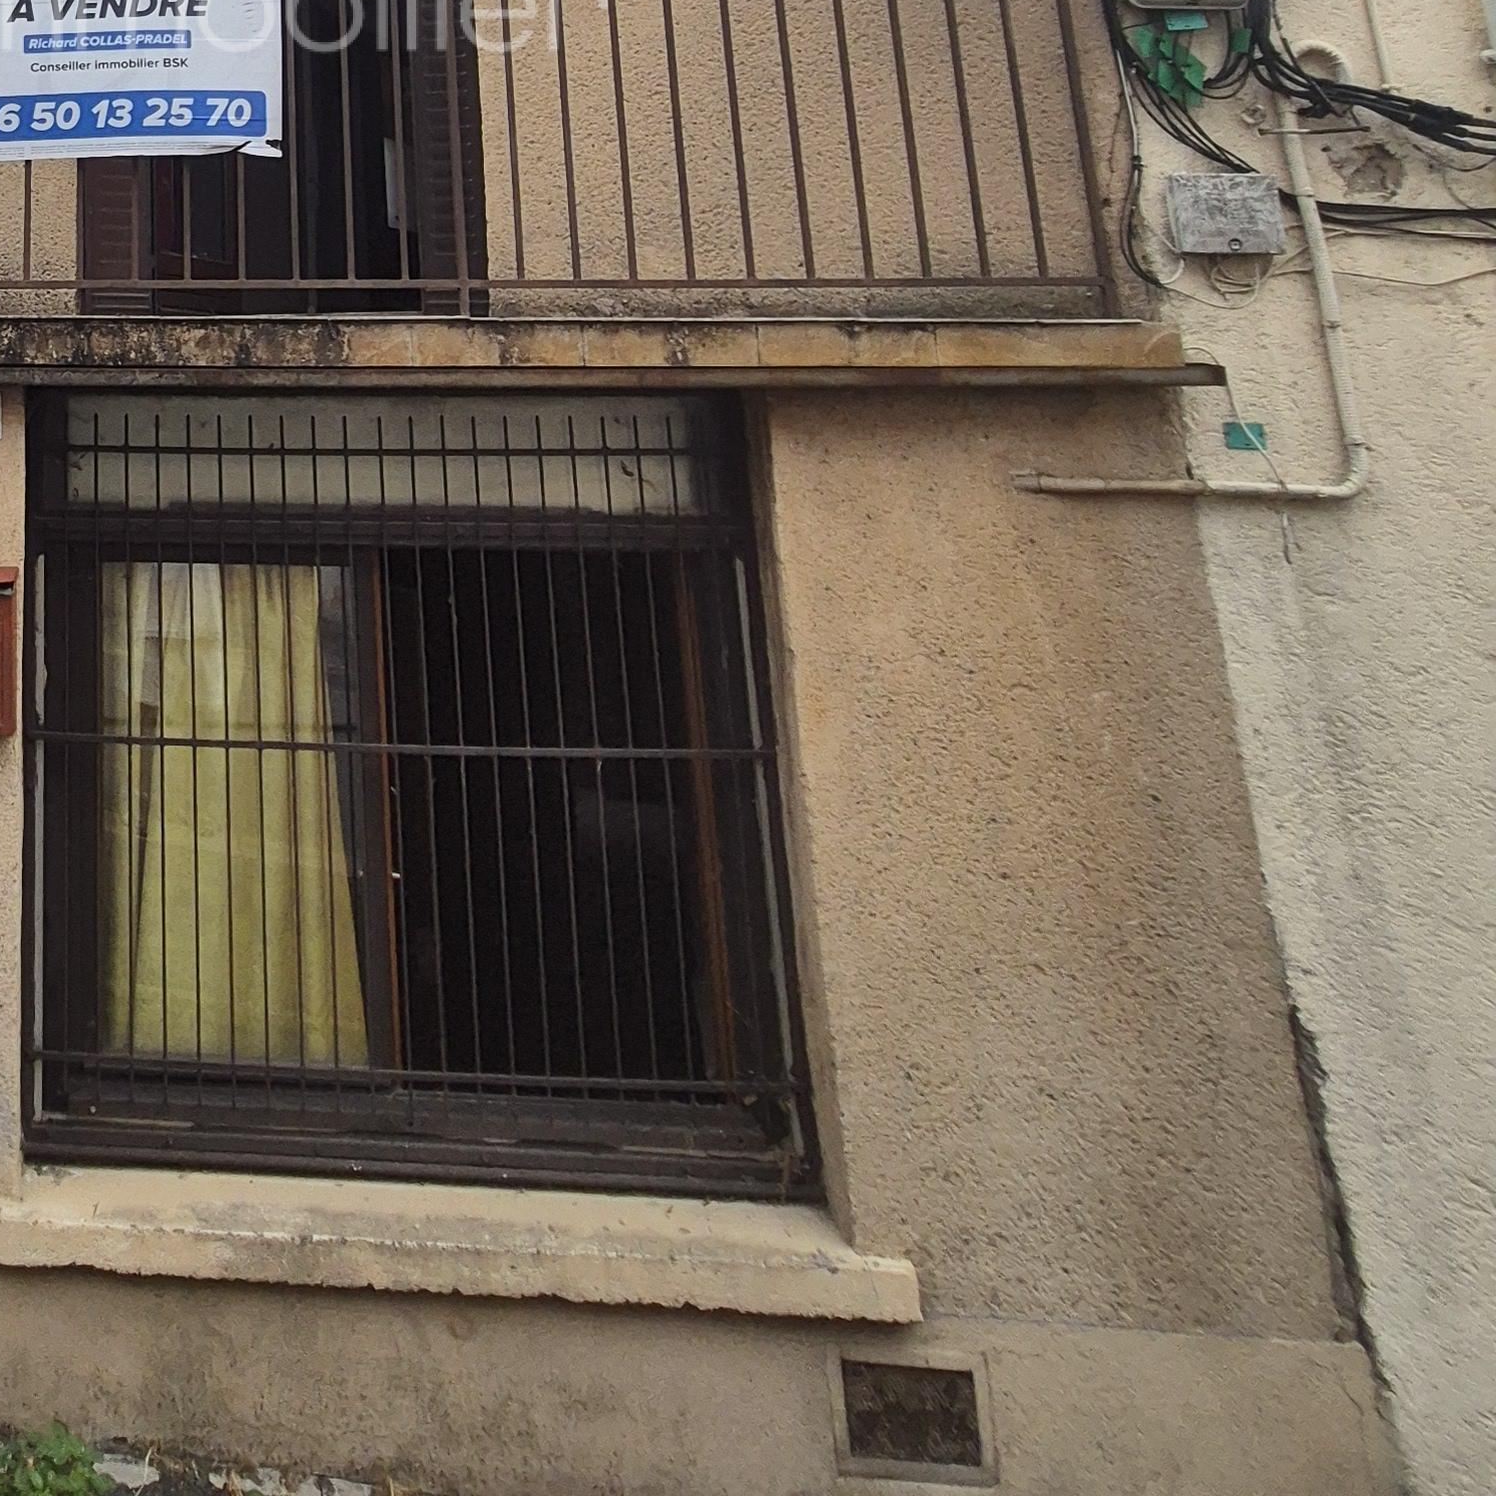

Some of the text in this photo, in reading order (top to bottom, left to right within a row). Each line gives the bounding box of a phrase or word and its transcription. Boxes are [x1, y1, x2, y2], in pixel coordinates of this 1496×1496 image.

[28, 34, 188, 50] Richard COLLAS-PRADEL
[30, 57, 189, 73] Conseiller immobilier BSK
[30, 101, 81, 132] 50
[91, 99, 134, 130] 13
[143, 98, 195, 128] 25
[206, 97, 253, 127] 70
